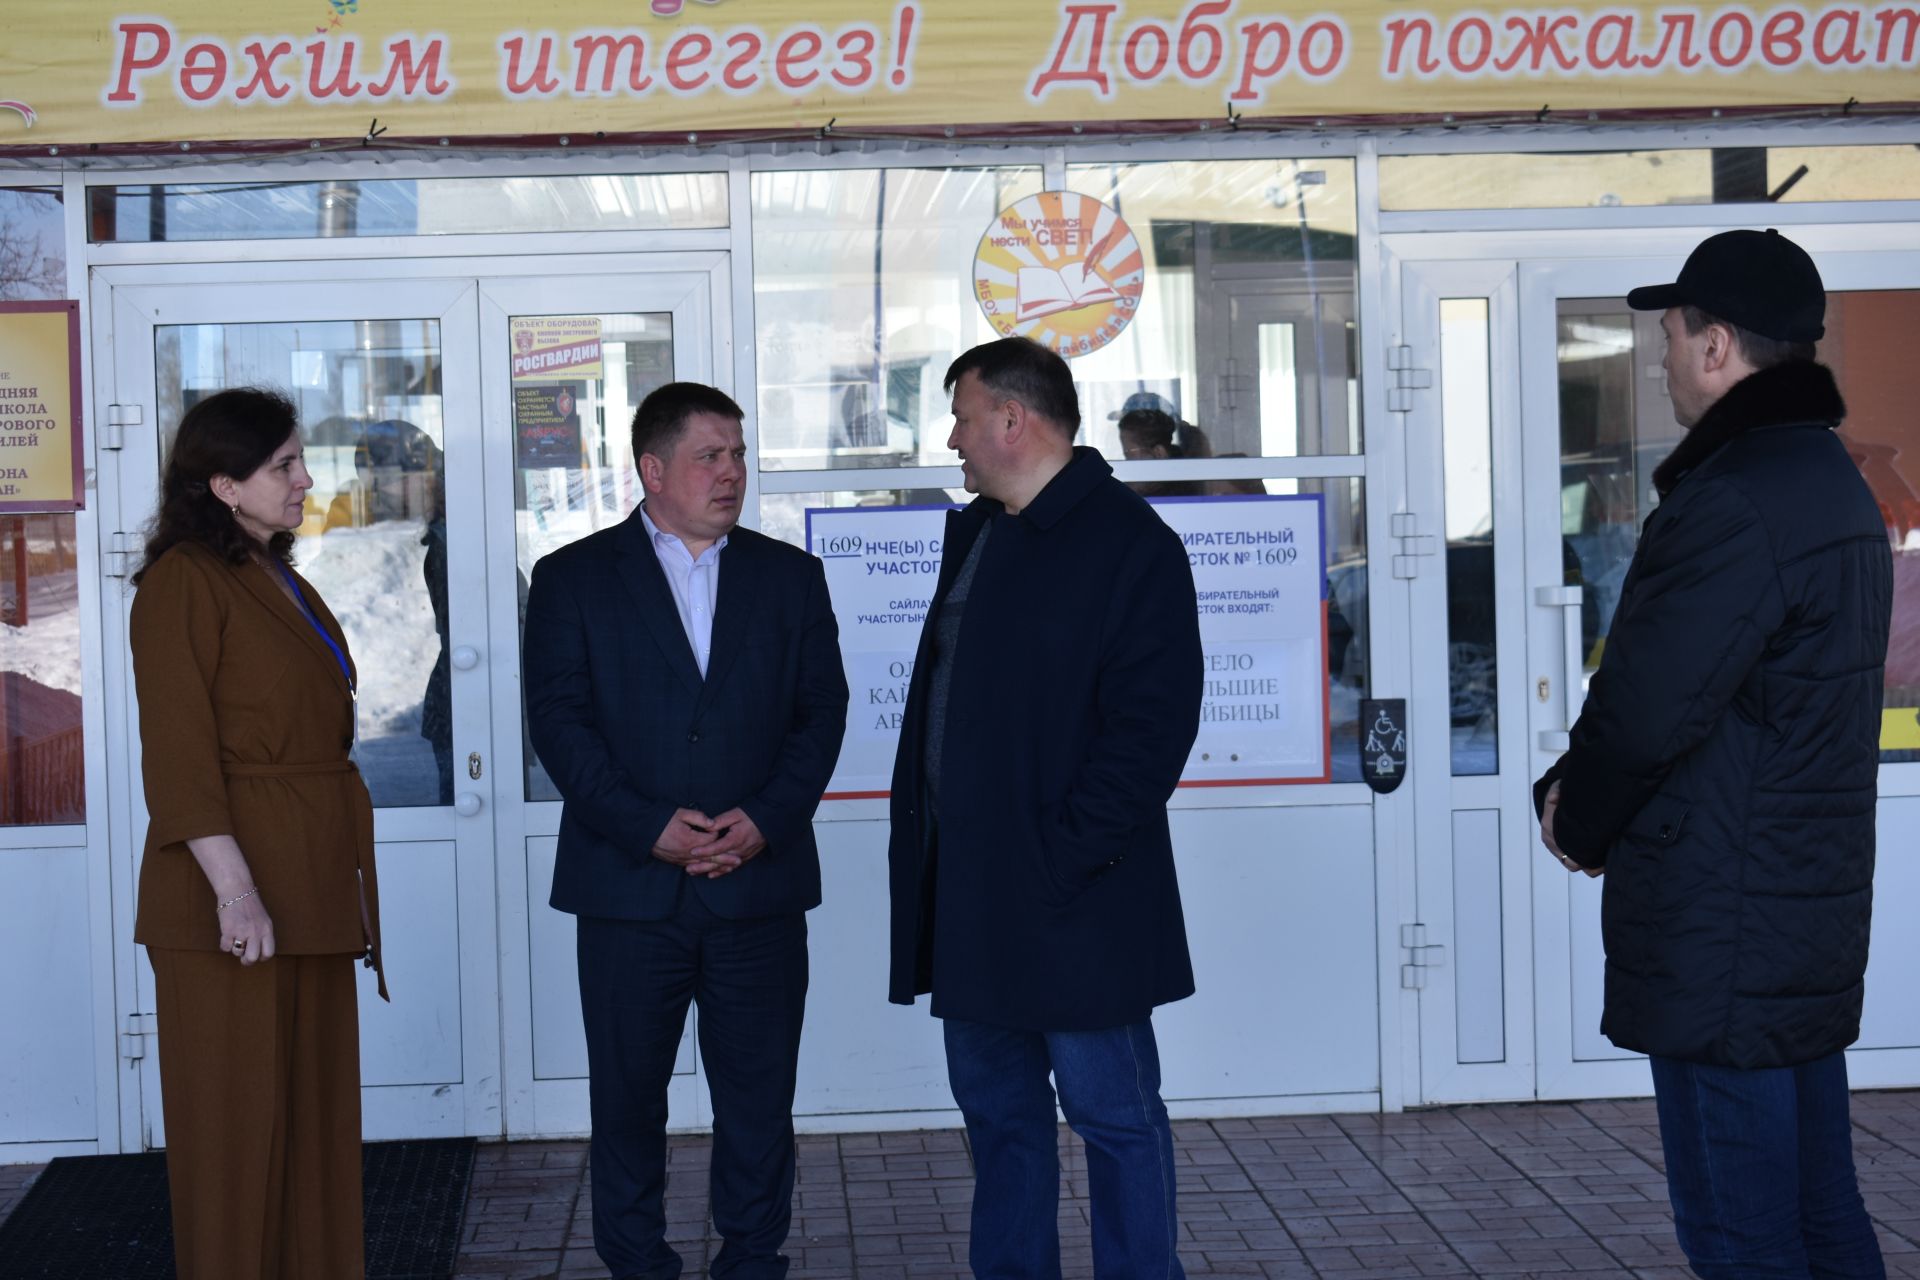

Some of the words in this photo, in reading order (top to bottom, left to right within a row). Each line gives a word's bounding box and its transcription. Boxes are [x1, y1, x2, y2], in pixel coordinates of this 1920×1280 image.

[108, 24, 449, 101] Рәхим
[503, 6, 914, 93] итегез!
[1032, 0, 1343, 100] Добро
[1001, 217, 1027, 229] Мы
[1036, 228, 1093, 246] СВЕТ!
[978, 279, 1001, 316] МБОУ
[547, 319, 598, 328] ОБОРУДОВАН
[514, 343, 599, 373] РОСГВАРДИИ
[820, 536, 862, 554] 1609
[866, 539, 924, 557] НЧЕ(Ы)
[1255, 547, 1297, 565] 1609
[1228, 603, 1274, 614] ВХОДЯТ:
